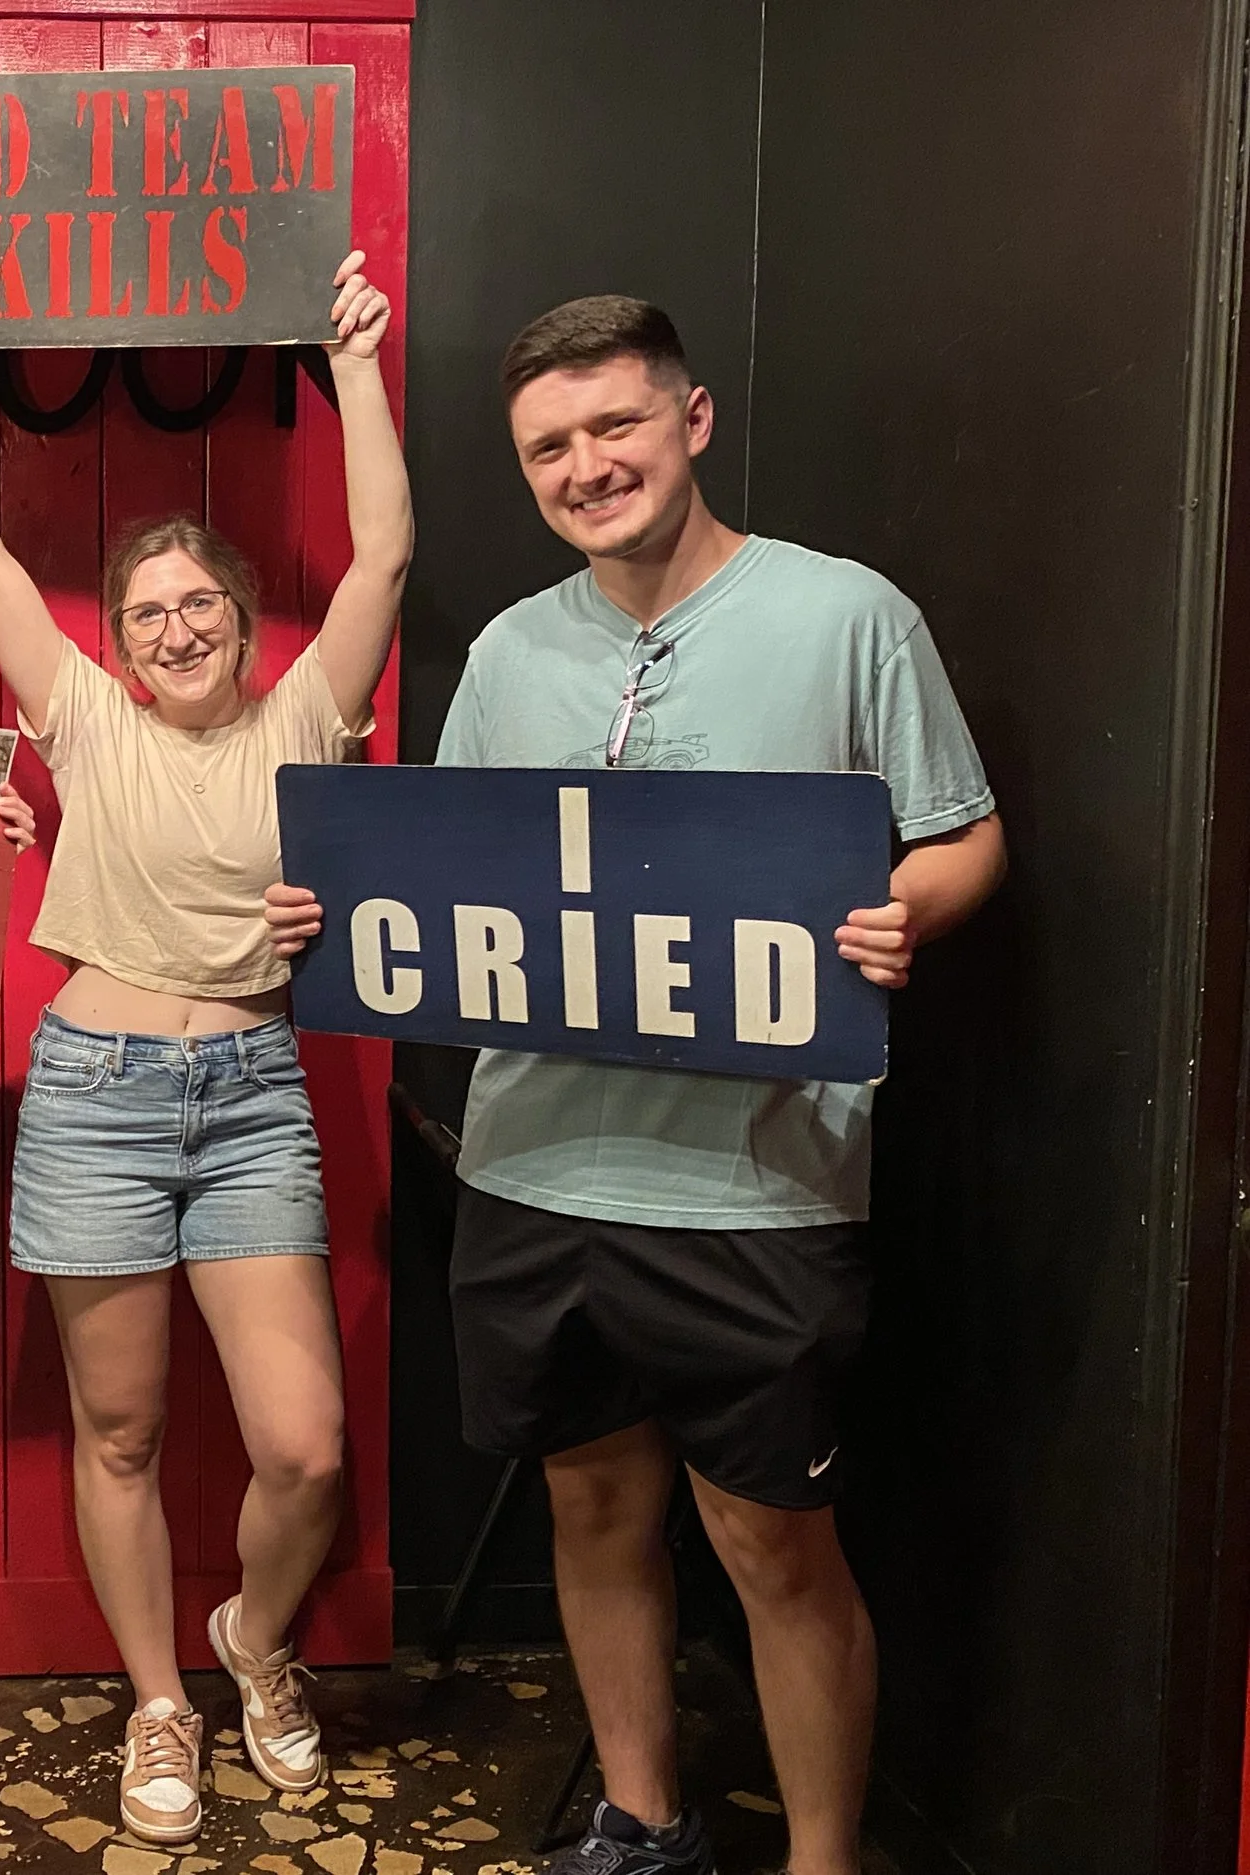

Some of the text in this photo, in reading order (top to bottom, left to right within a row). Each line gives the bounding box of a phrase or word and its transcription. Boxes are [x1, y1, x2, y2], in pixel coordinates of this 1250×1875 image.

[76, 84, 338, 197] TEAM
[558, 786, 592, 894] I
[350, 897, 817, 1047] CRIED
